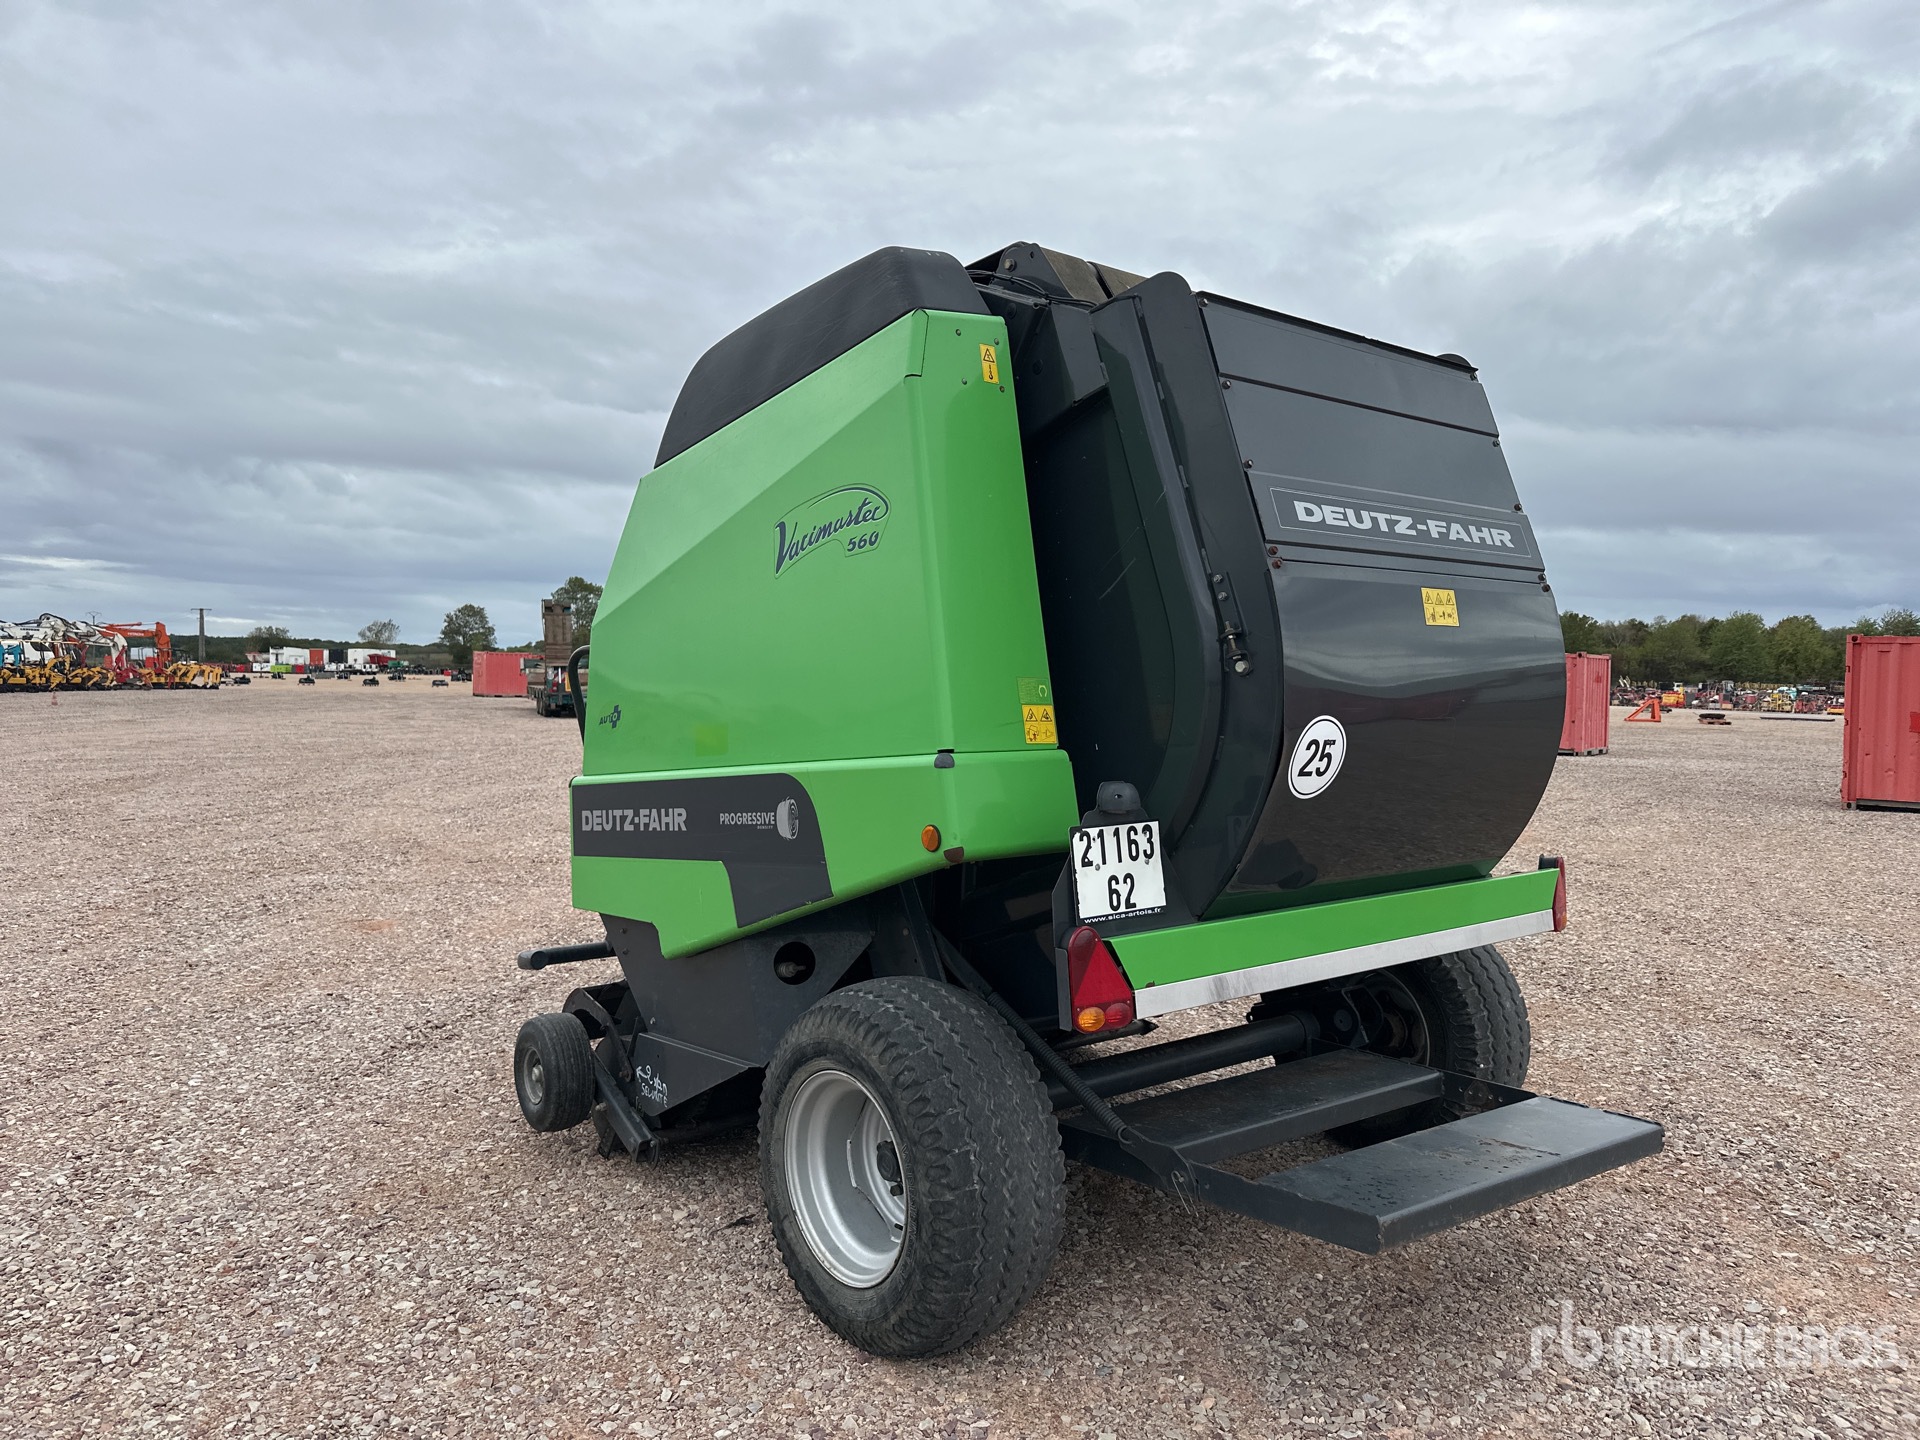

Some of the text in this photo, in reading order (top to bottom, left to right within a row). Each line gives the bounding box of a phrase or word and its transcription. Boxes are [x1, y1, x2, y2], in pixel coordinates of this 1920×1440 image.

[1293, 500, 1515, 549] DEUTZ-FAHR
[846, 530, 880, 553] 560
[1297, 738, 1337, 778] 25
[581, 807, 688, 832] DEUTZ-FAHR
[719, 811, 776, 825] PROGRESSIVE
[1079, 823, 1155, 868] 21163
[1107, 872, 1137, 912] 62
[1084, 907, 1163, 924] www.sica-artois.fr
